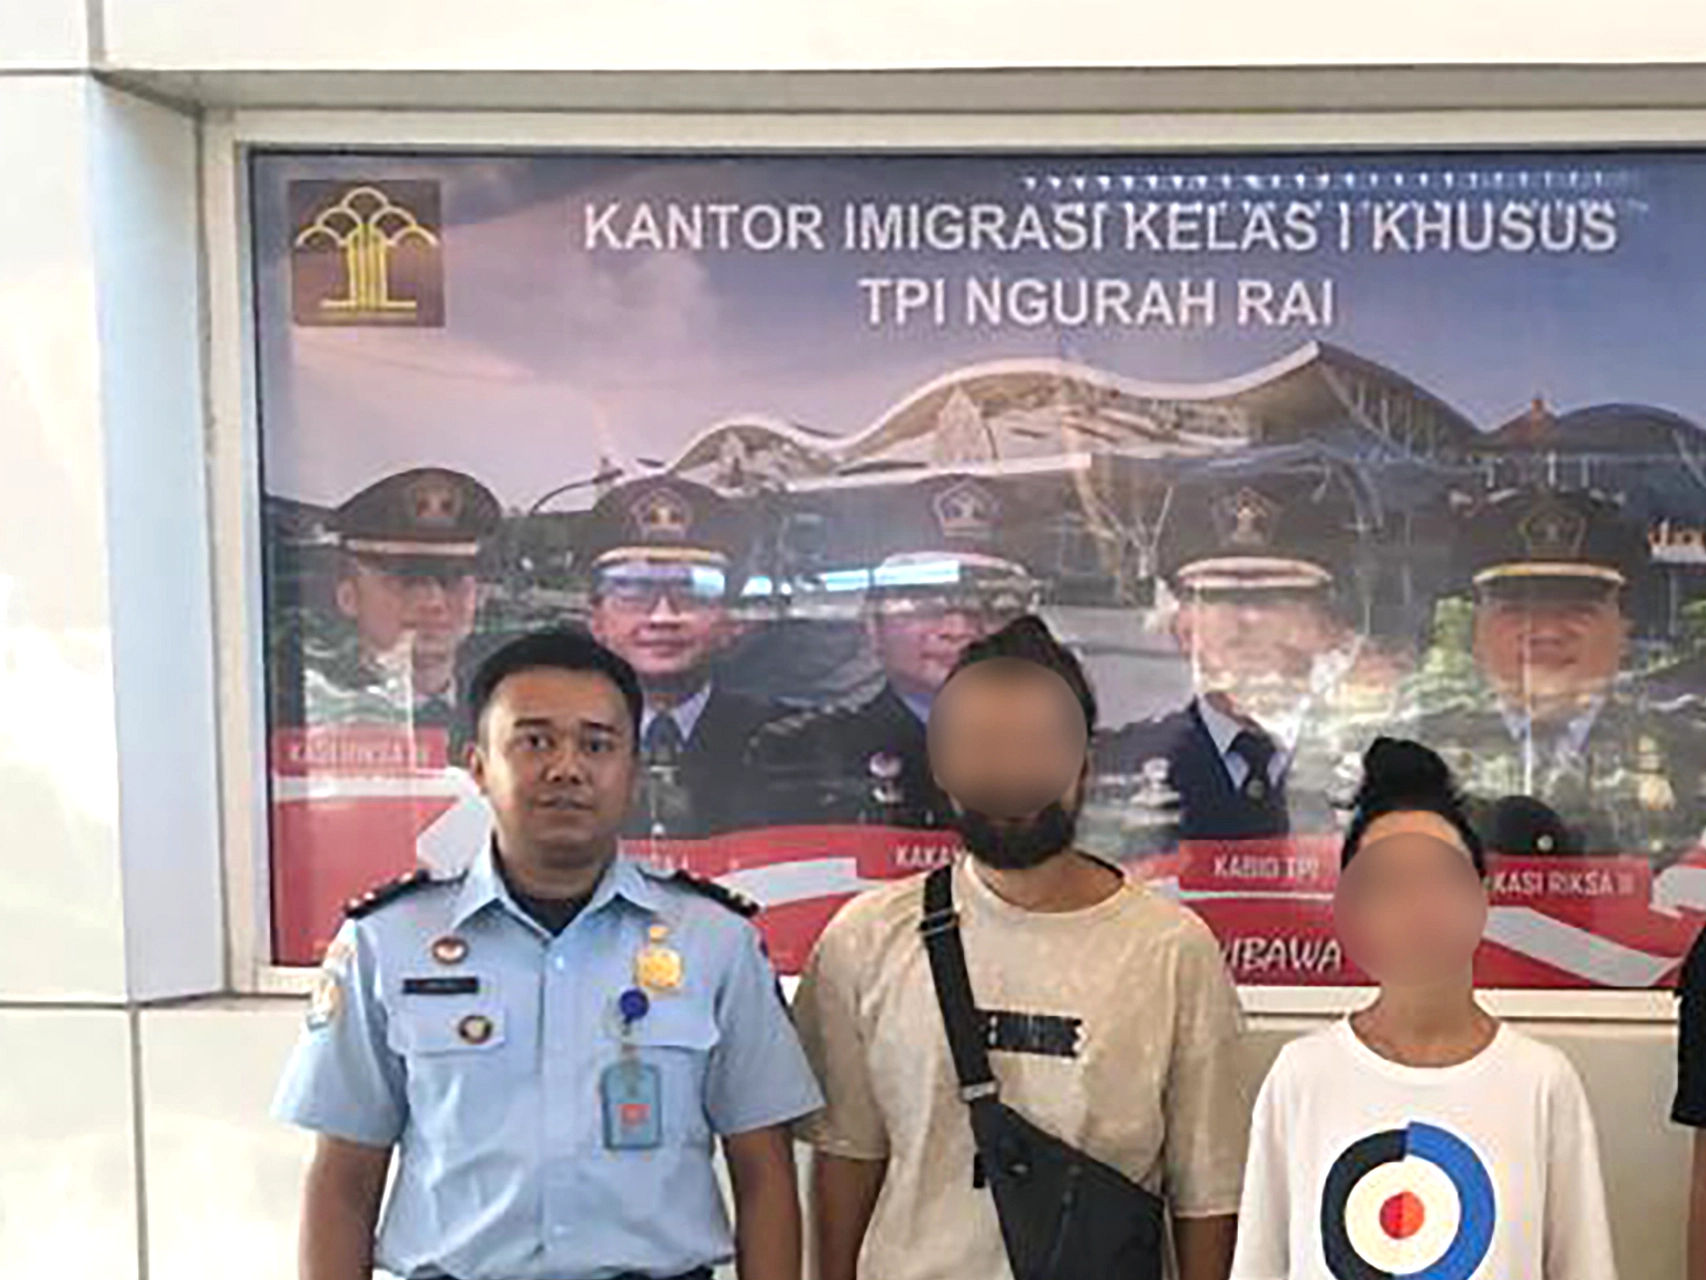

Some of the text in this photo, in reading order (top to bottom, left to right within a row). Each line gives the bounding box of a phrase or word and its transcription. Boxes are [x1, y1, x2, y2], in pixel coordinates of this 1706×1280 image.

[583, 202, 1619, 253] KANTOR IMIGRASI KELAS I KHUSUS
[857, 277, 1333, 326] TPI NGURAH RAI
[1226, 935, 1342, 973] IBAWA
